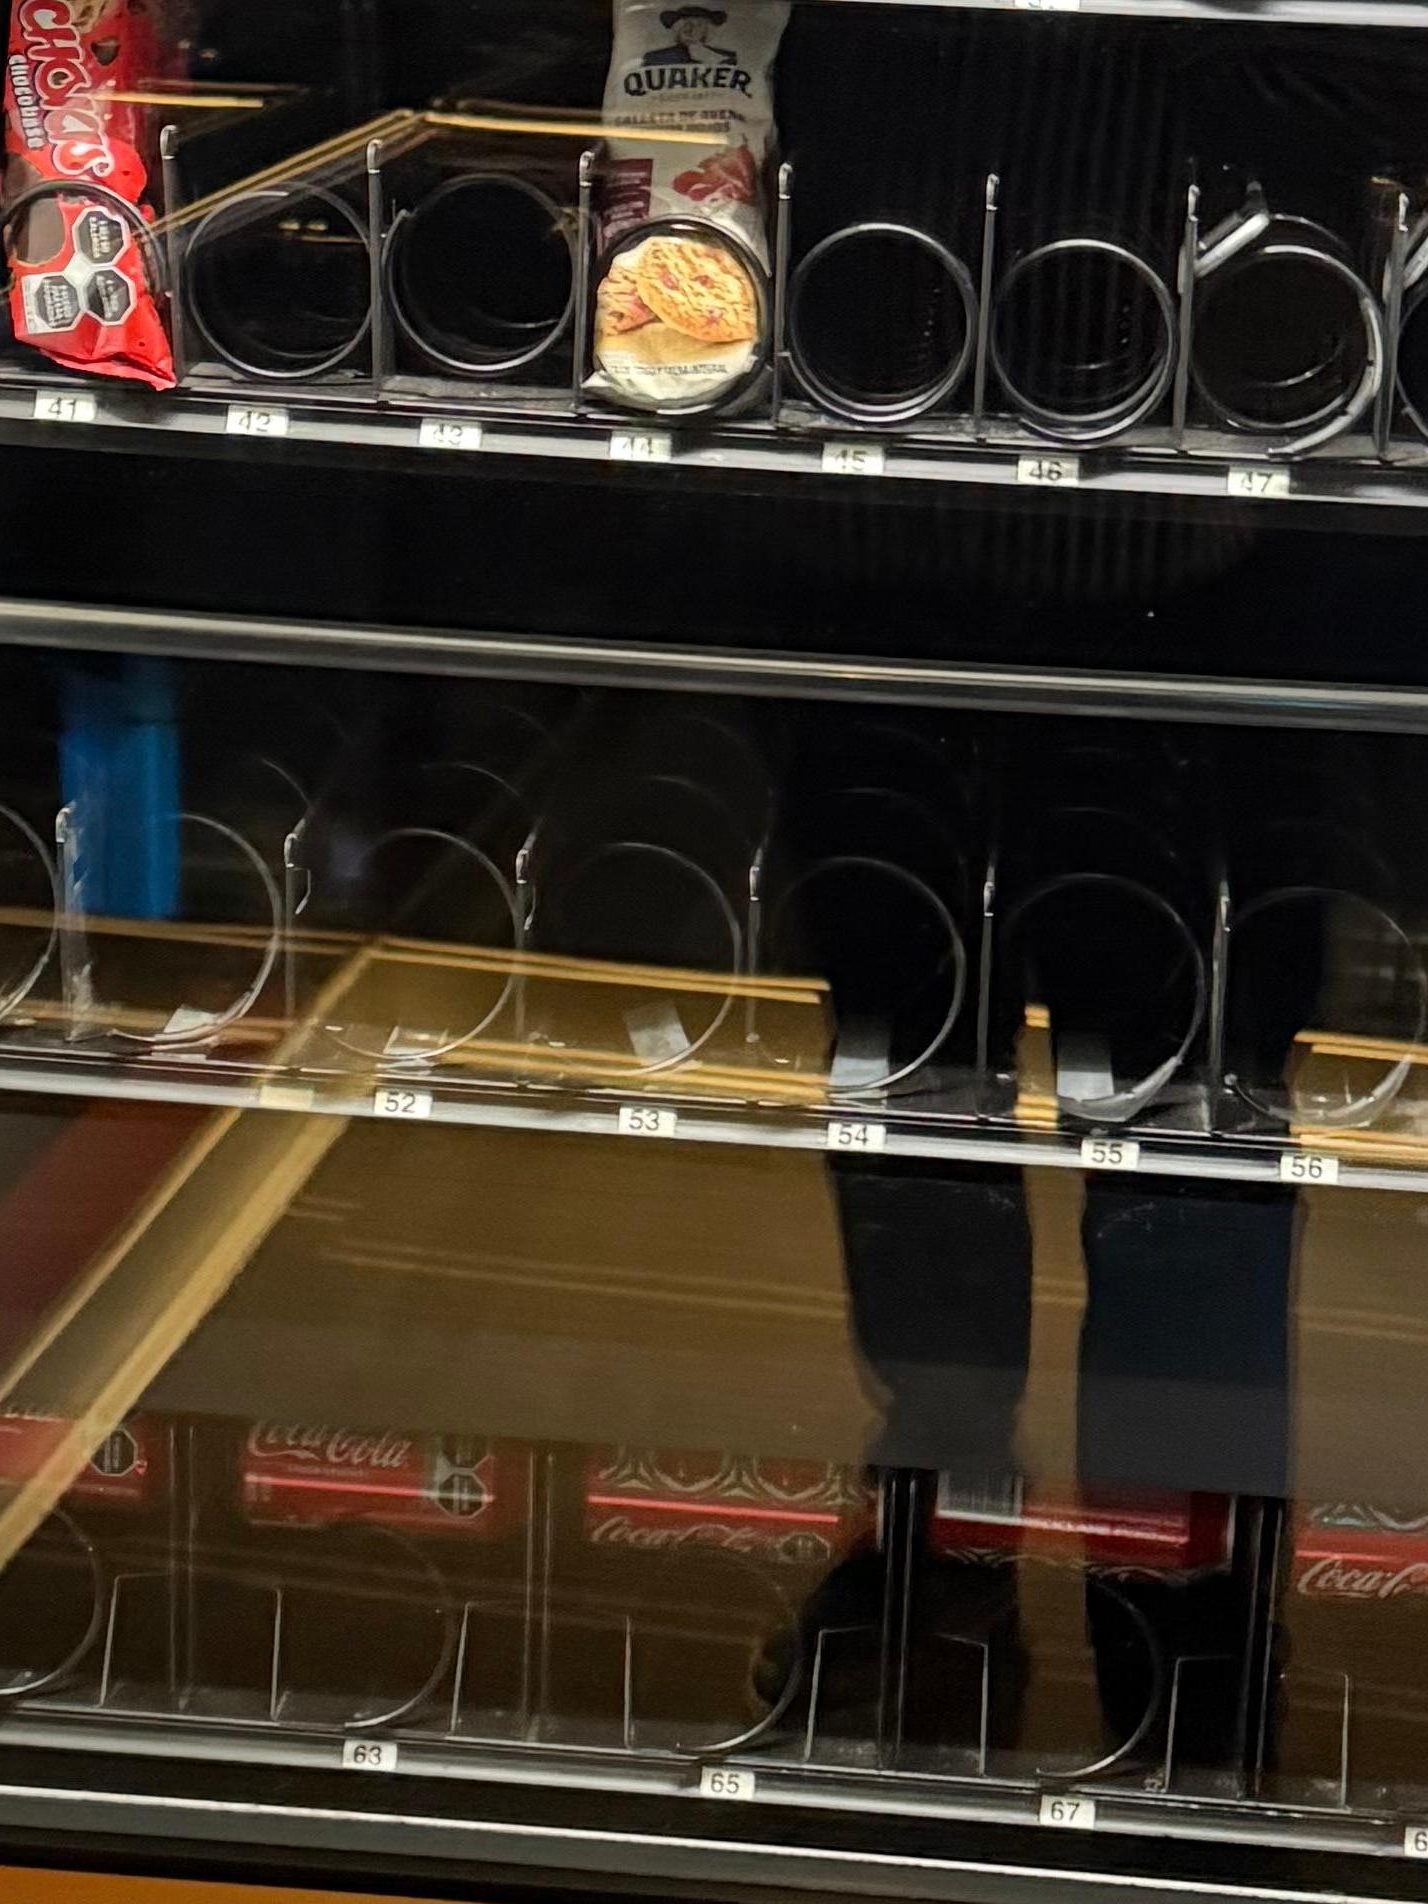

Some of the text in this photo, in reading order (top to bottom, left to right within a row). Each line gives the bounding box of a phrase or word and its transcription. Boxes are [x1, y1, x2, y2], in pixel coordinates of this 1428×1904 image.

[623, 66, 753, 98] QUAKER
[47, 398, 76, 417] 41
[238, 410, 271, 432] 42
[432, 423, 464, 445] 43
[622, 436, 653, 456] 44
[835, 449, 866, 471] 45
[1029, 460, 1063, 481] 46
[1241, 470, 1273, 492] 47
[384, 1092, 416, 1113] 52
[628, 1110, 660, 1131] 53
[838, 1123, 869, 1145] 54
[1091, 1142, 1123, 1164] 55
[1291, 1156, 1323, 1178] 56
[353, 1744, 382, 1765] 63
[710, 1772, 740, 1794] 65
[1050, 1800, 1081, 1821] 67
